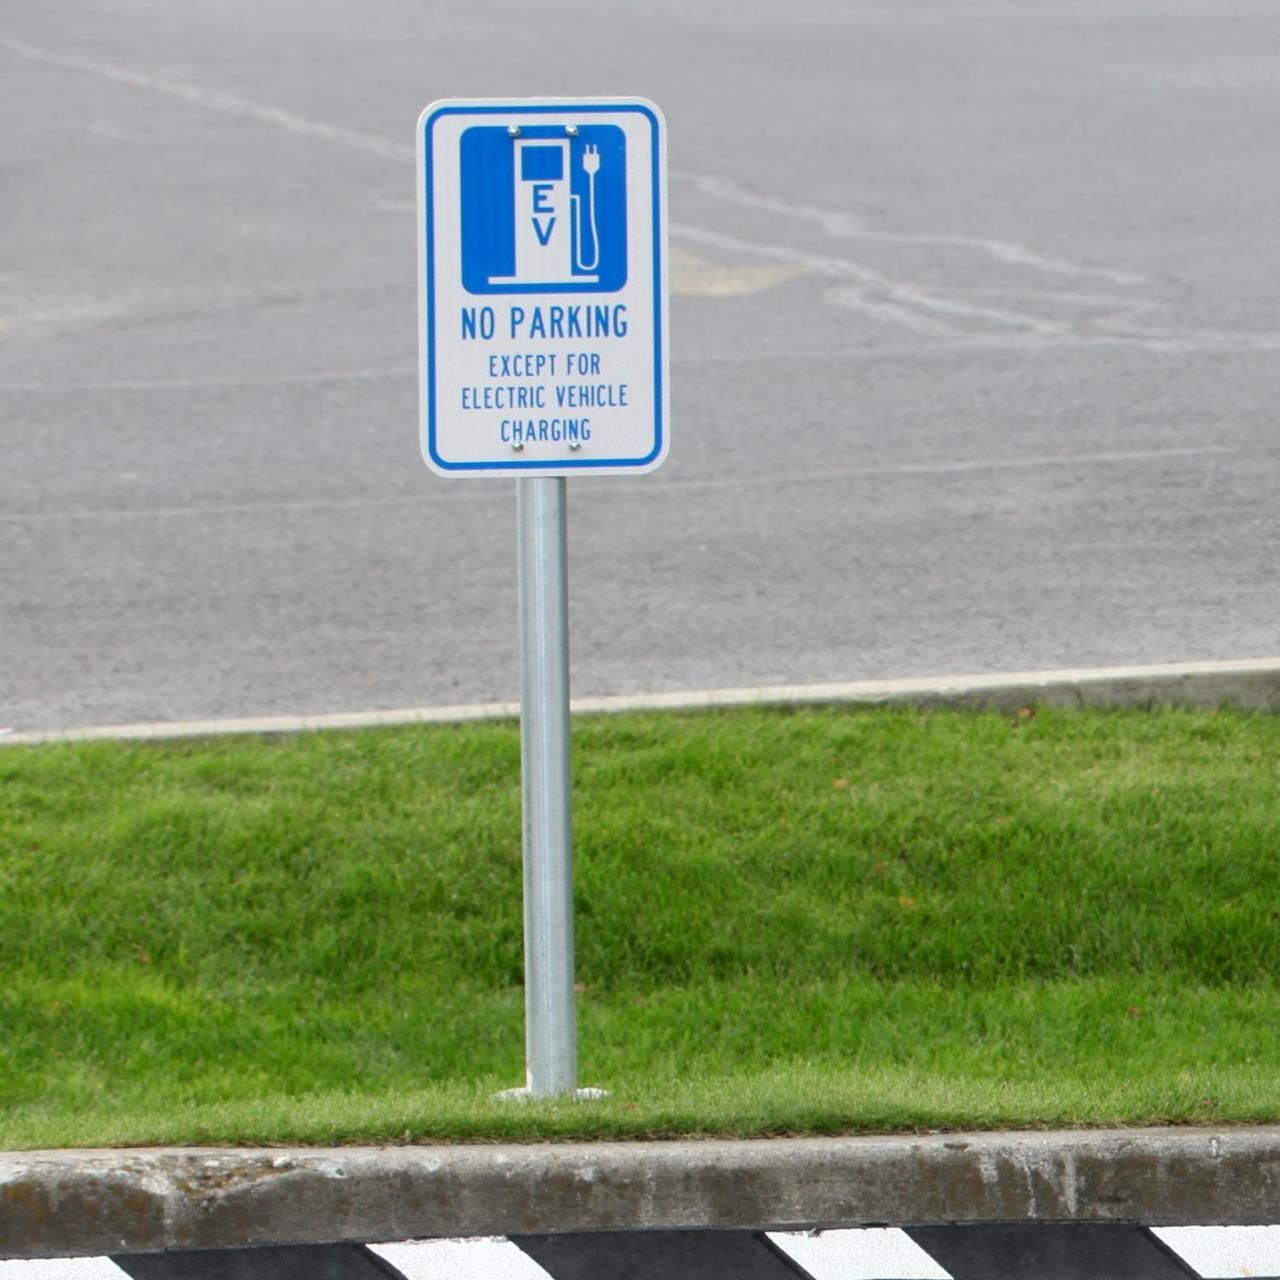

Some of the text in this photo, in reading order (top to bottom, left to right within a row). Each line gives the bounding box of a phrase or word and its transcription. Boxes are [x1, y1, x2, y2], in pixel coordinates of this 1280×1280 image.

[532, 184, 556, 246] EV
[461, 304, 628, 340] NO PARKING
[489, 353, 601, 377] EXCEPT FOR
[461, 384, 628, 410] ELECTRIC VEHICLE
[501, 419, 591, 442] CHARGING
